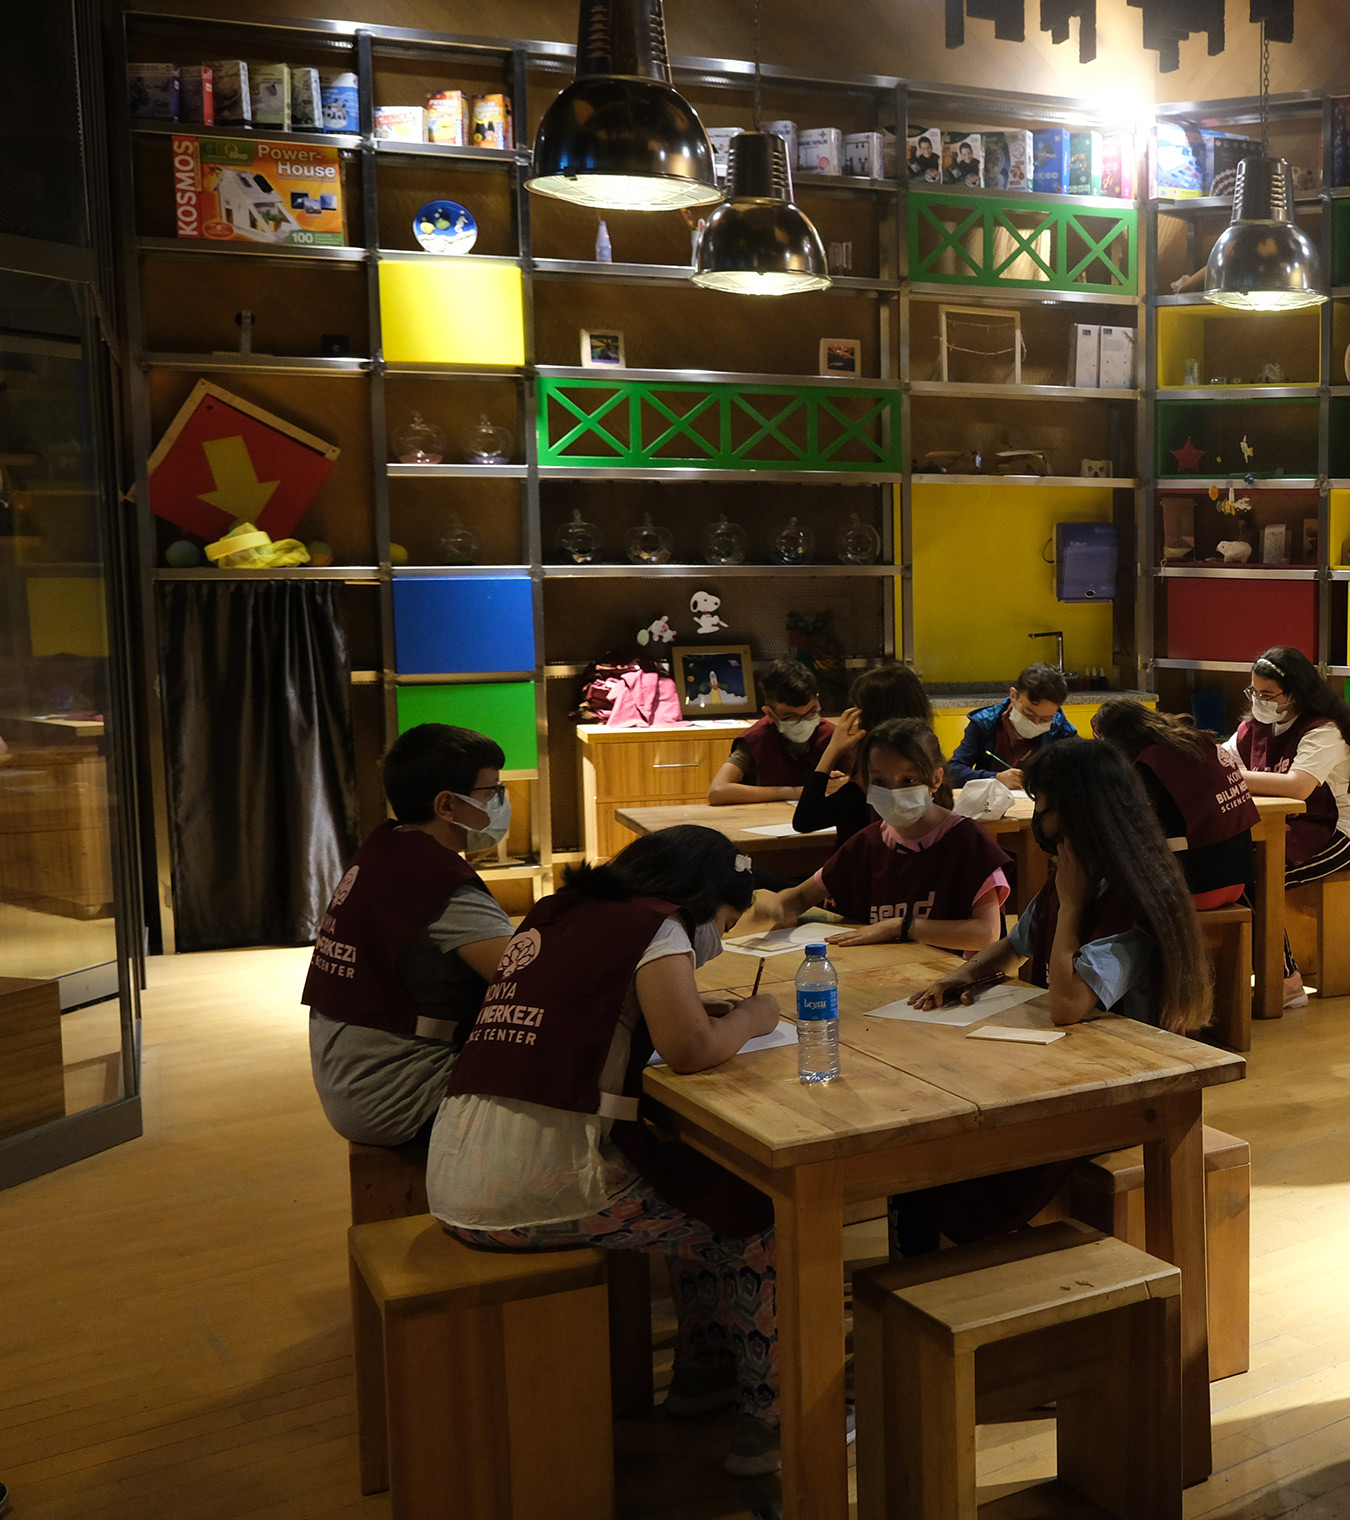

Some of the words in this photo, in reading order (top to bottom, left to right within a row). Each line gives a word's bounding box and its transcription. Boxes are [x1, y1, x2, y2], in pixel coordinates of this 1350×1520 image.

[257, 144, 323, 162] Power-
[277, 161, 337, 178] House
[172, 140, 199, 236] KOSMOS
[291, 232, 314, 244] 100
